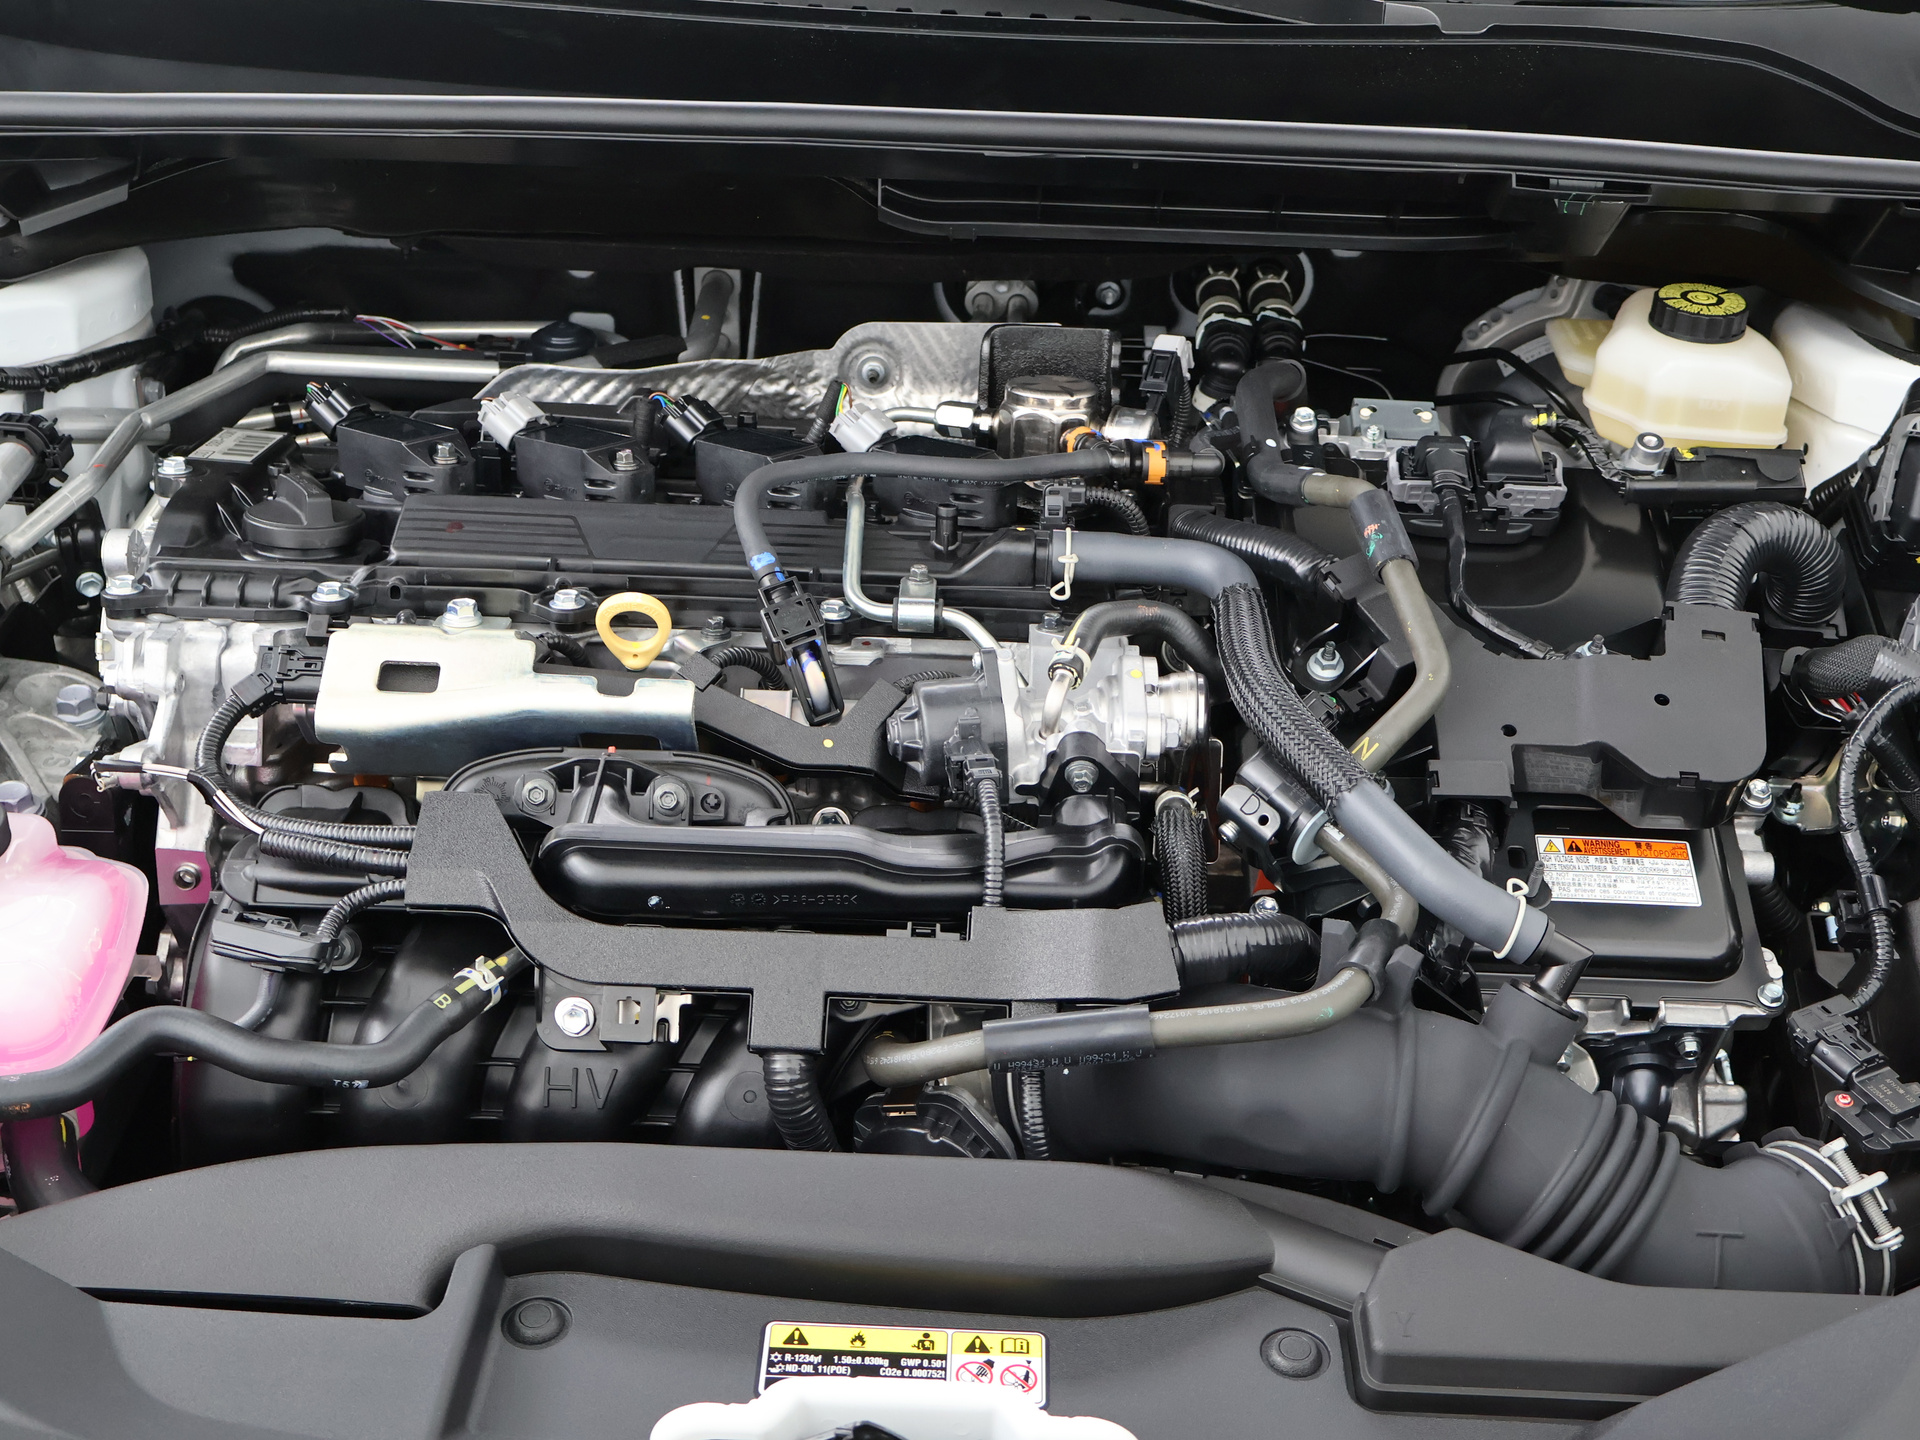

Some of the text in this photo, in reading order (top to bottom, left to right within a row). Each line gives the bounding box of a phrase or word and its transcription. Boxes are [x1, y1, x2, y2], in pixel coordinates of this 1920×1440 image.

[1239, 793, 1261, 816] D
[1582, 839, 1620, 849] WARNING
[1583, 847, 1631, 856] AVERTISSEMENT
[1554, 856, 1575, 864] VOLTAGE
[1575, 856, 1590, 865] INSIDE
[1557, 863, 1577, 871] TENSION
[432, 993, 452, 1010] B
[543, 1066, 617, 1110] HV
[784, 1353, 946, 1368] R-1234yf 1.50±0.030kg GWP 0.501
[785, 1363, 816, 1374] ND-OIL
[817, 1365, 851, 1376] 11(POE)
